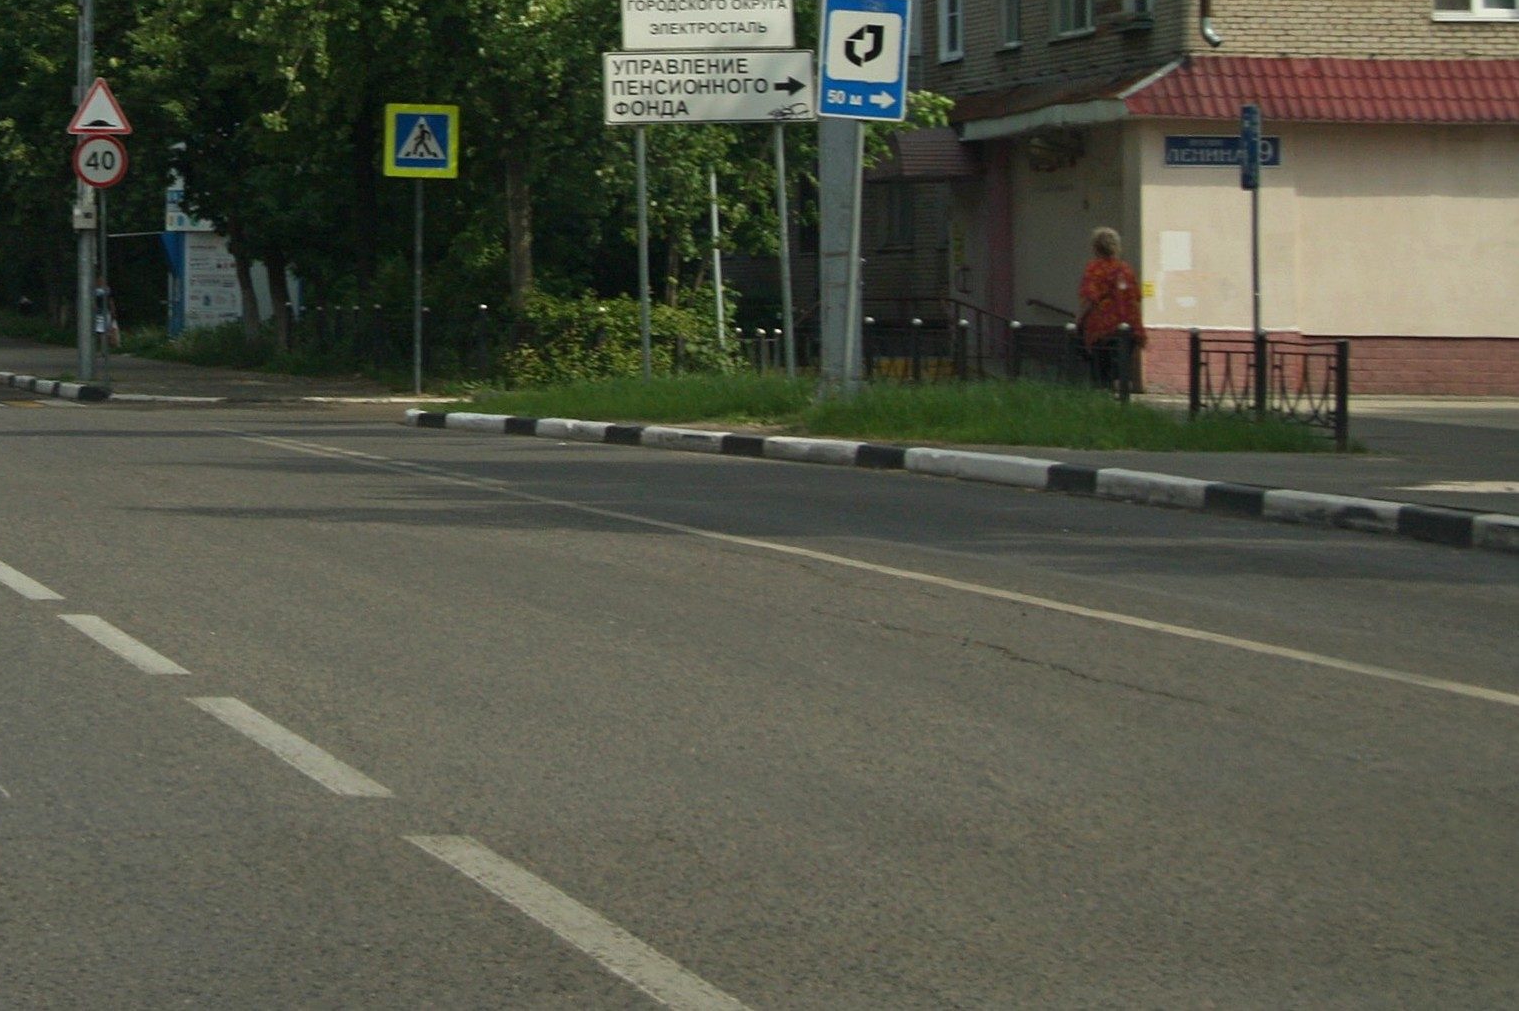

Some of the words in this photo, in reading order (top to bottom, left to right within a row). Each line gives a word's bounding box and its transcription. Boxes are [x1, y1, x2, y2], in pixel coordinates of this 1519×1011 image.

[627, 0, 726, 13] ГОРОДСКОГО
[649, 21, 767, 35] ЭЛЕКТРОСТАЛЬ
[612, 58, 749, 75] УПРАВЛЕНИЕ
[612, 78, 769, 96] ПЕНСИОННОГО
[827, 90, 846, 104] 50
[614, 100, 689, 118] ФОНДА
[85, 151, 115, 170] 40
